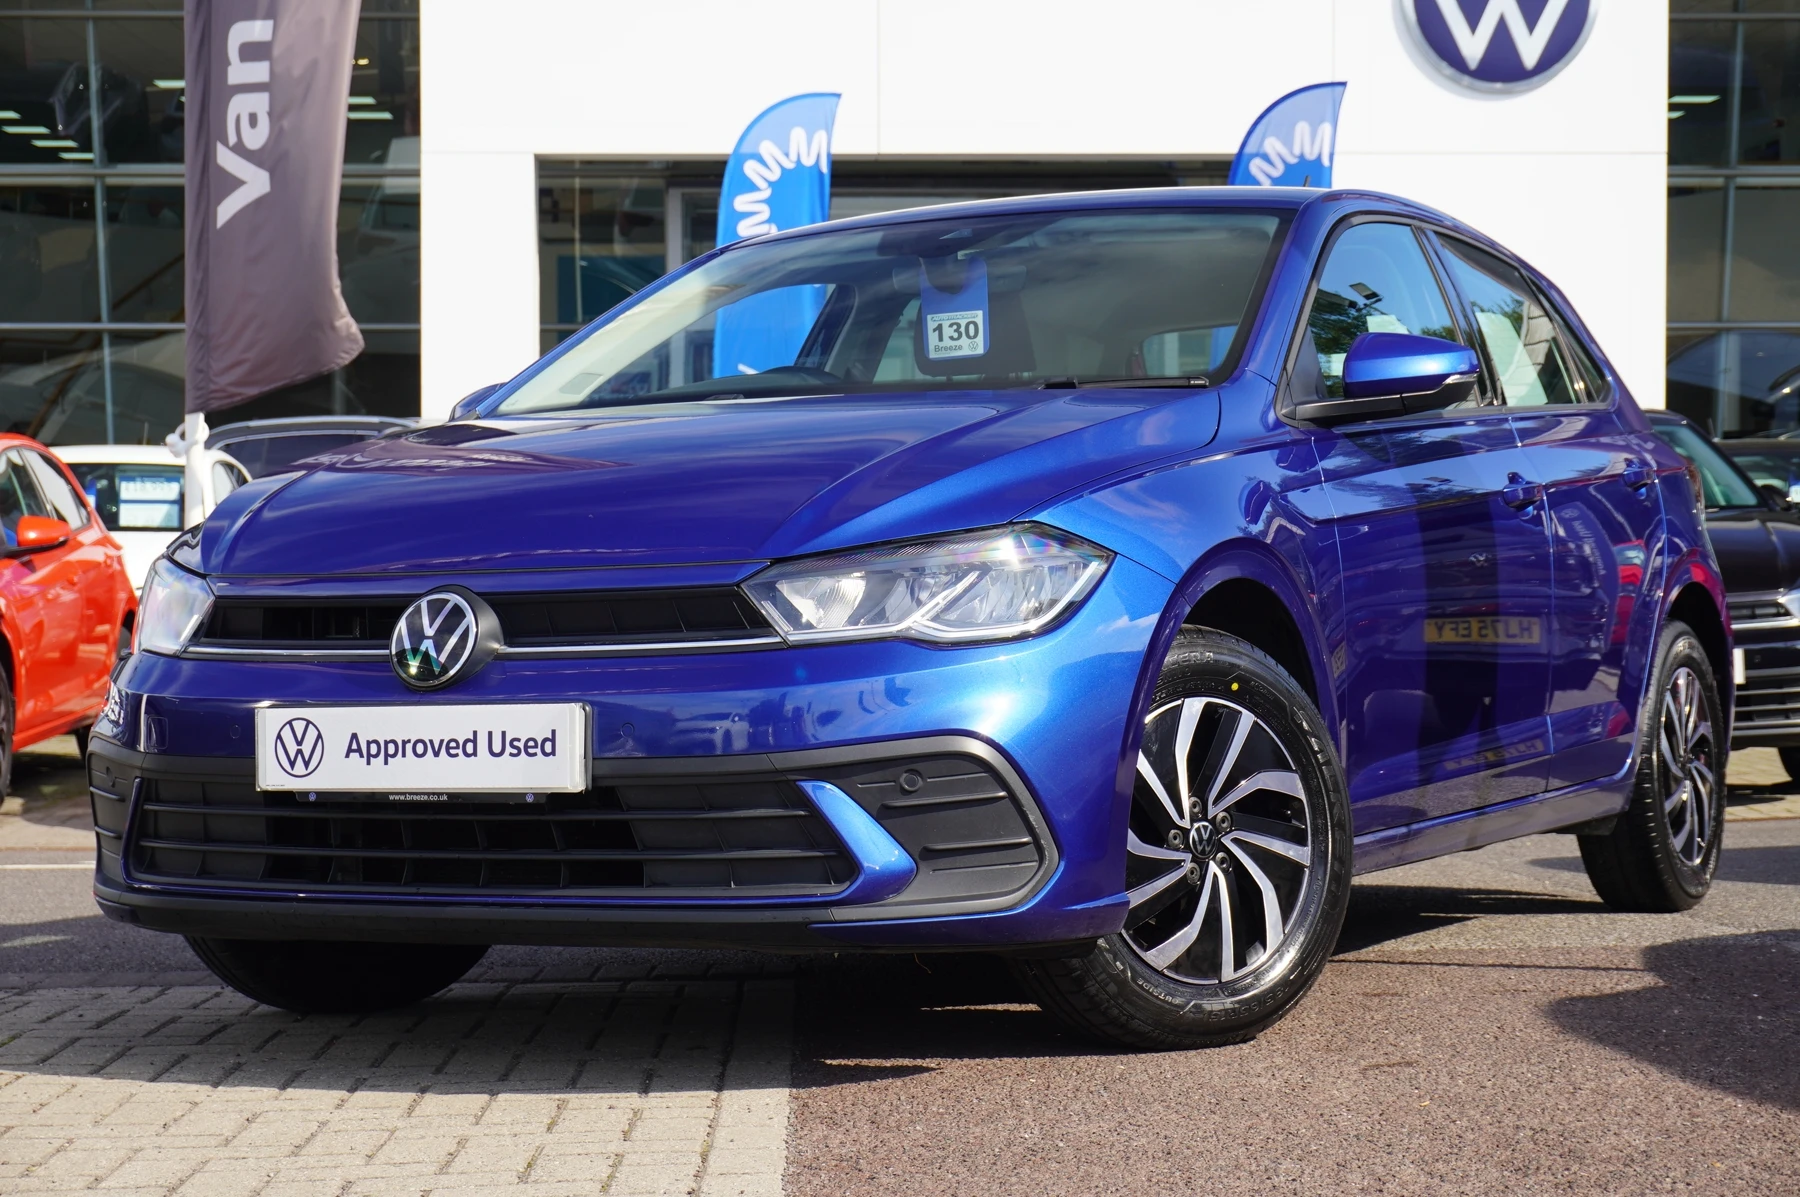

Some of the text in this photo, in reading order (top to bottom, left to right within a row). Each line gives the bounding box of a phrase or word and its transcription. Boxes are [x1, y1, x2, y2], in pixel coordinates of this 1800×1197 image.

[216, 19, 274, 230] Van
[932, 320, 980, 343] 130
[934, 344, 963, 352] Breeze
[344, 729, 557, 766] Approved Used
[388, 793, 448, 801] www.breeze.co.uk
[1136, 977, 1180, 1005] OUTSIDE
